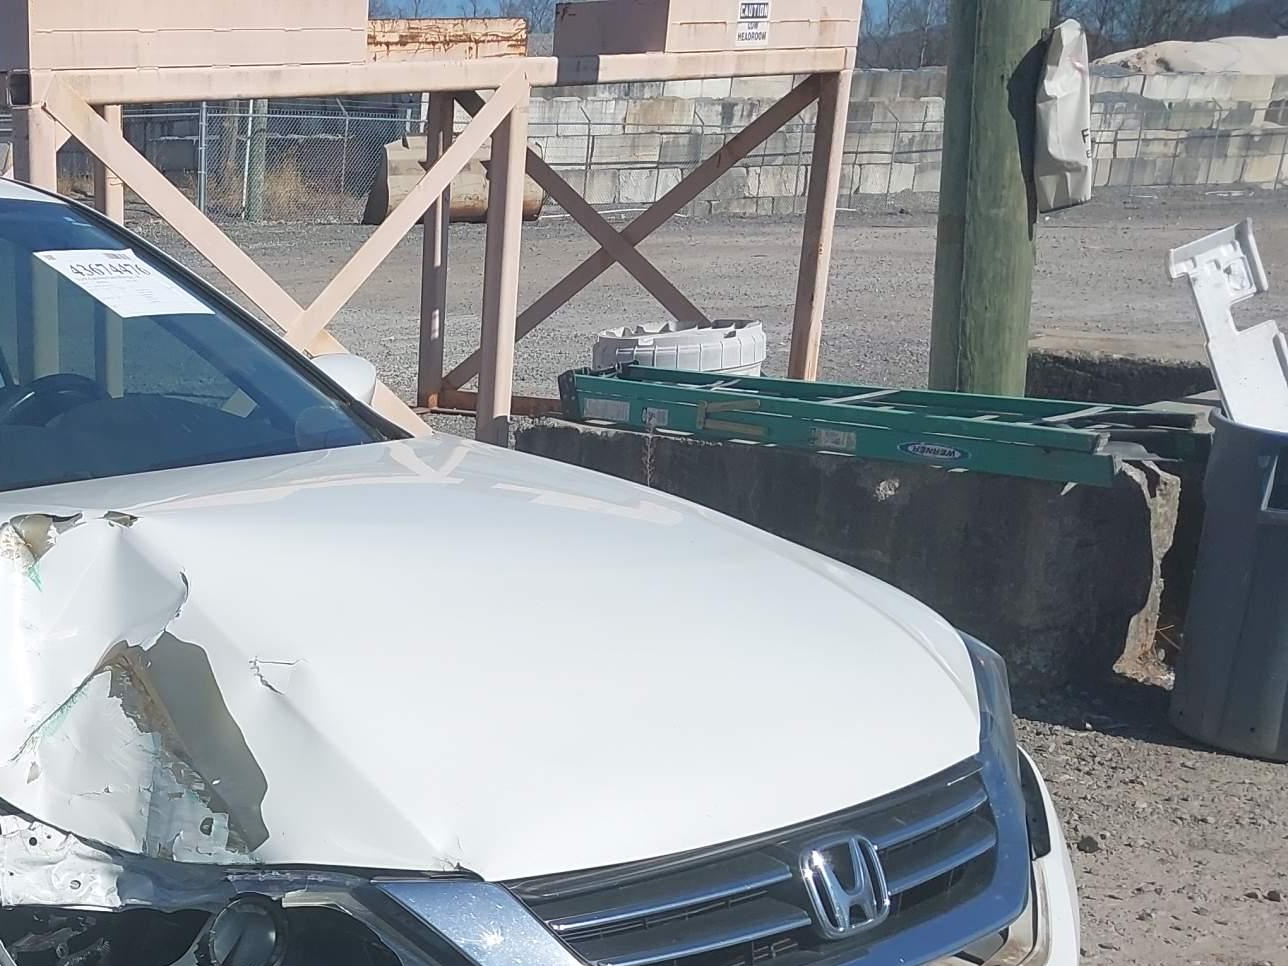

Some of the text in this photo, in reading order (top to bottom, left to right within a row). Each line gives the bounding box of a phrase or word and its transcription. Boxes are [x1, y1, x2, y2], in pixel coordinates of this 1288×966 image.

[740, 4, 768, 17] CAUTION
[738, 32, 767, 41] HEADROOM
[70, 263, 152, 277] 43674476
